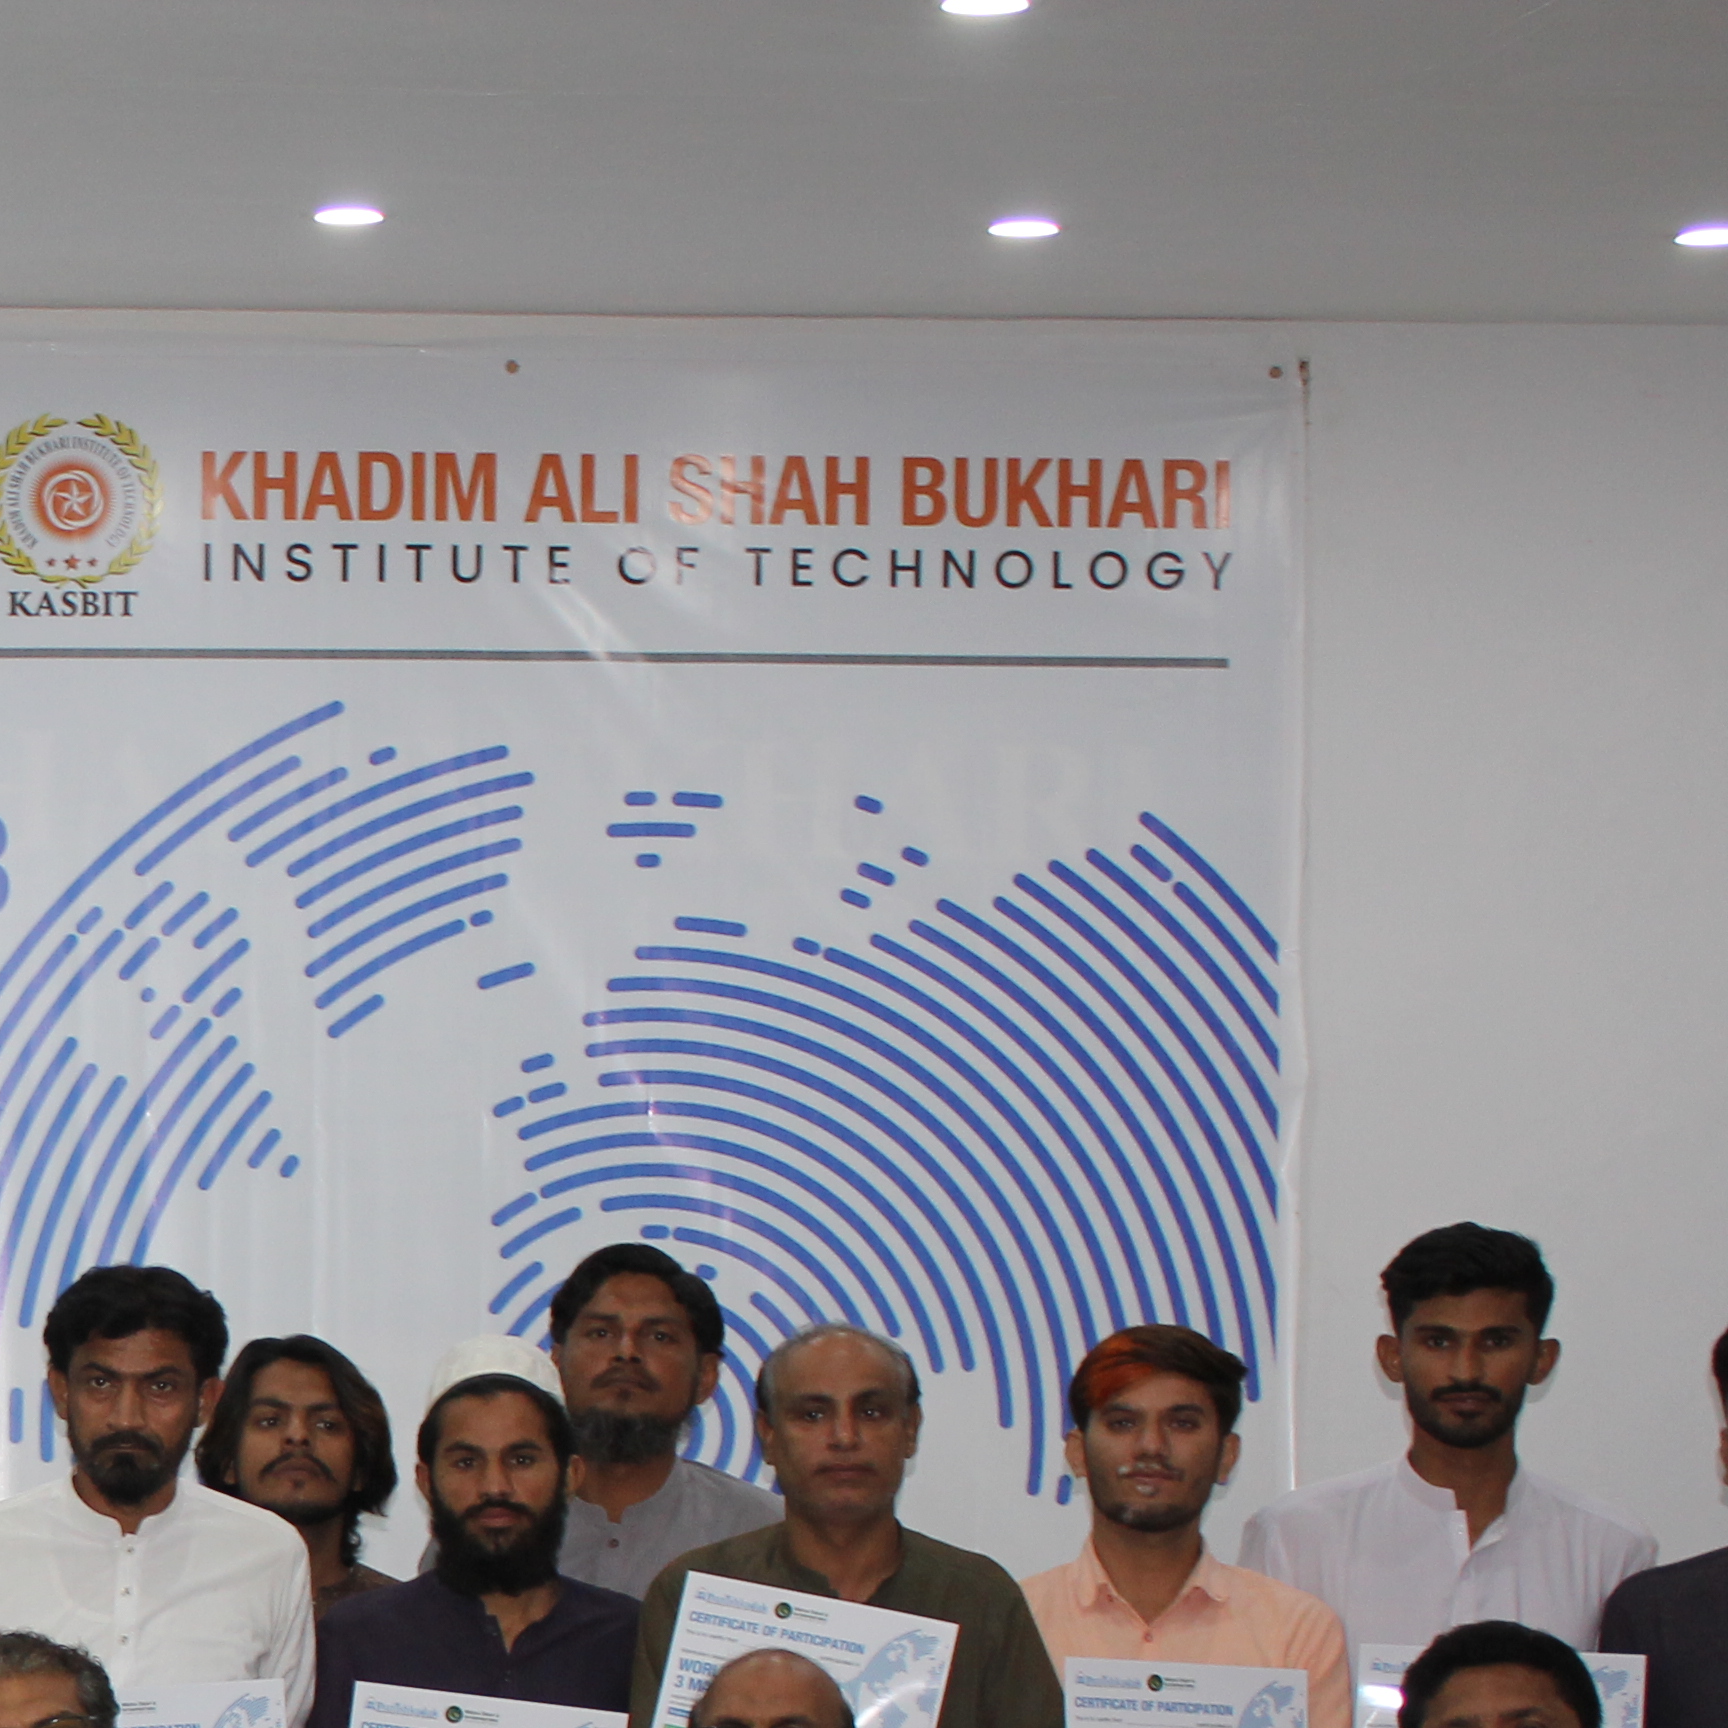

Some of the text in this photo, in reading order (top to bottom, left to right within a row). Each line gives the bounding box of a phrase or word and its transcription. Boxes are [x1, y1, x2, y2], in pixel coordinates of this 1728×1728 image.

[201, 451, 1232, 530] KHADIM ALI SHAH BUKHARI
[204, 544, 1233, 591] INSTITUTE OF TECHNOLOGY
[7, 590, 139, 618] KASBIT
